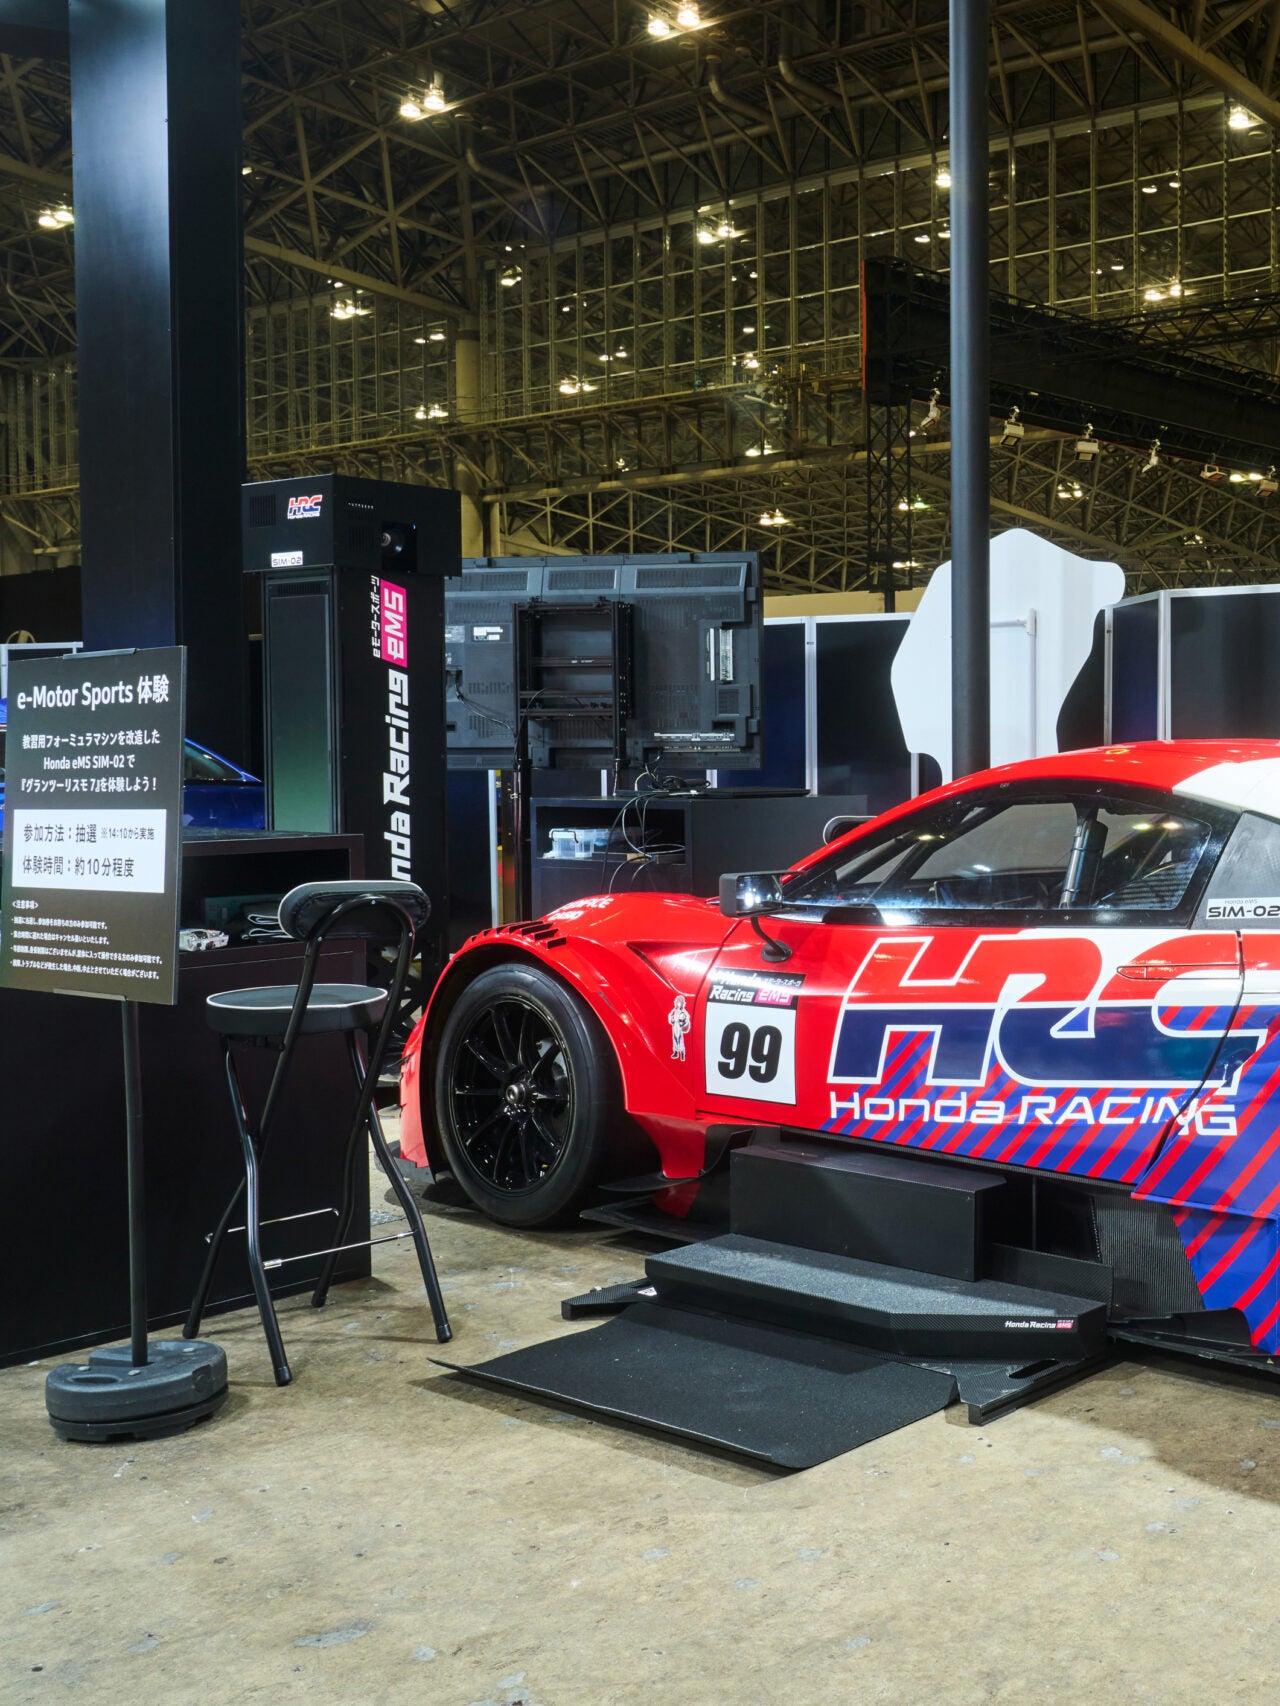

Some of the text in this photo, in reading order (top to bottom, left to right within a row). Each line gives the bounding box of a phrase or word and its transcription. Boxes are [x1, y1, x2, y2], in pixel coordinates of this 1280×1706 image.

[287, 494, 323, 515] HRC
[272, 557, 302, 567] SIM-02
[385, 588, 405, 661] eMS
[17, 674, 169, 711] e-Motor Sports 体験
[383, 668, 411, 807] Racing
[43, 754, 136, 770] Honda eMS SIM-02 で
[1208, 905, 1280, 918] SIM-02
[709, 985, 755, 1002] Racing
[717, 1021, 783, 1084] 99
[828, 1091, 1237, 1136] Honda RACING
[1004, 1320, 1029, 1328] Honda
[1029, 1321, 1056, 1329] Racing
